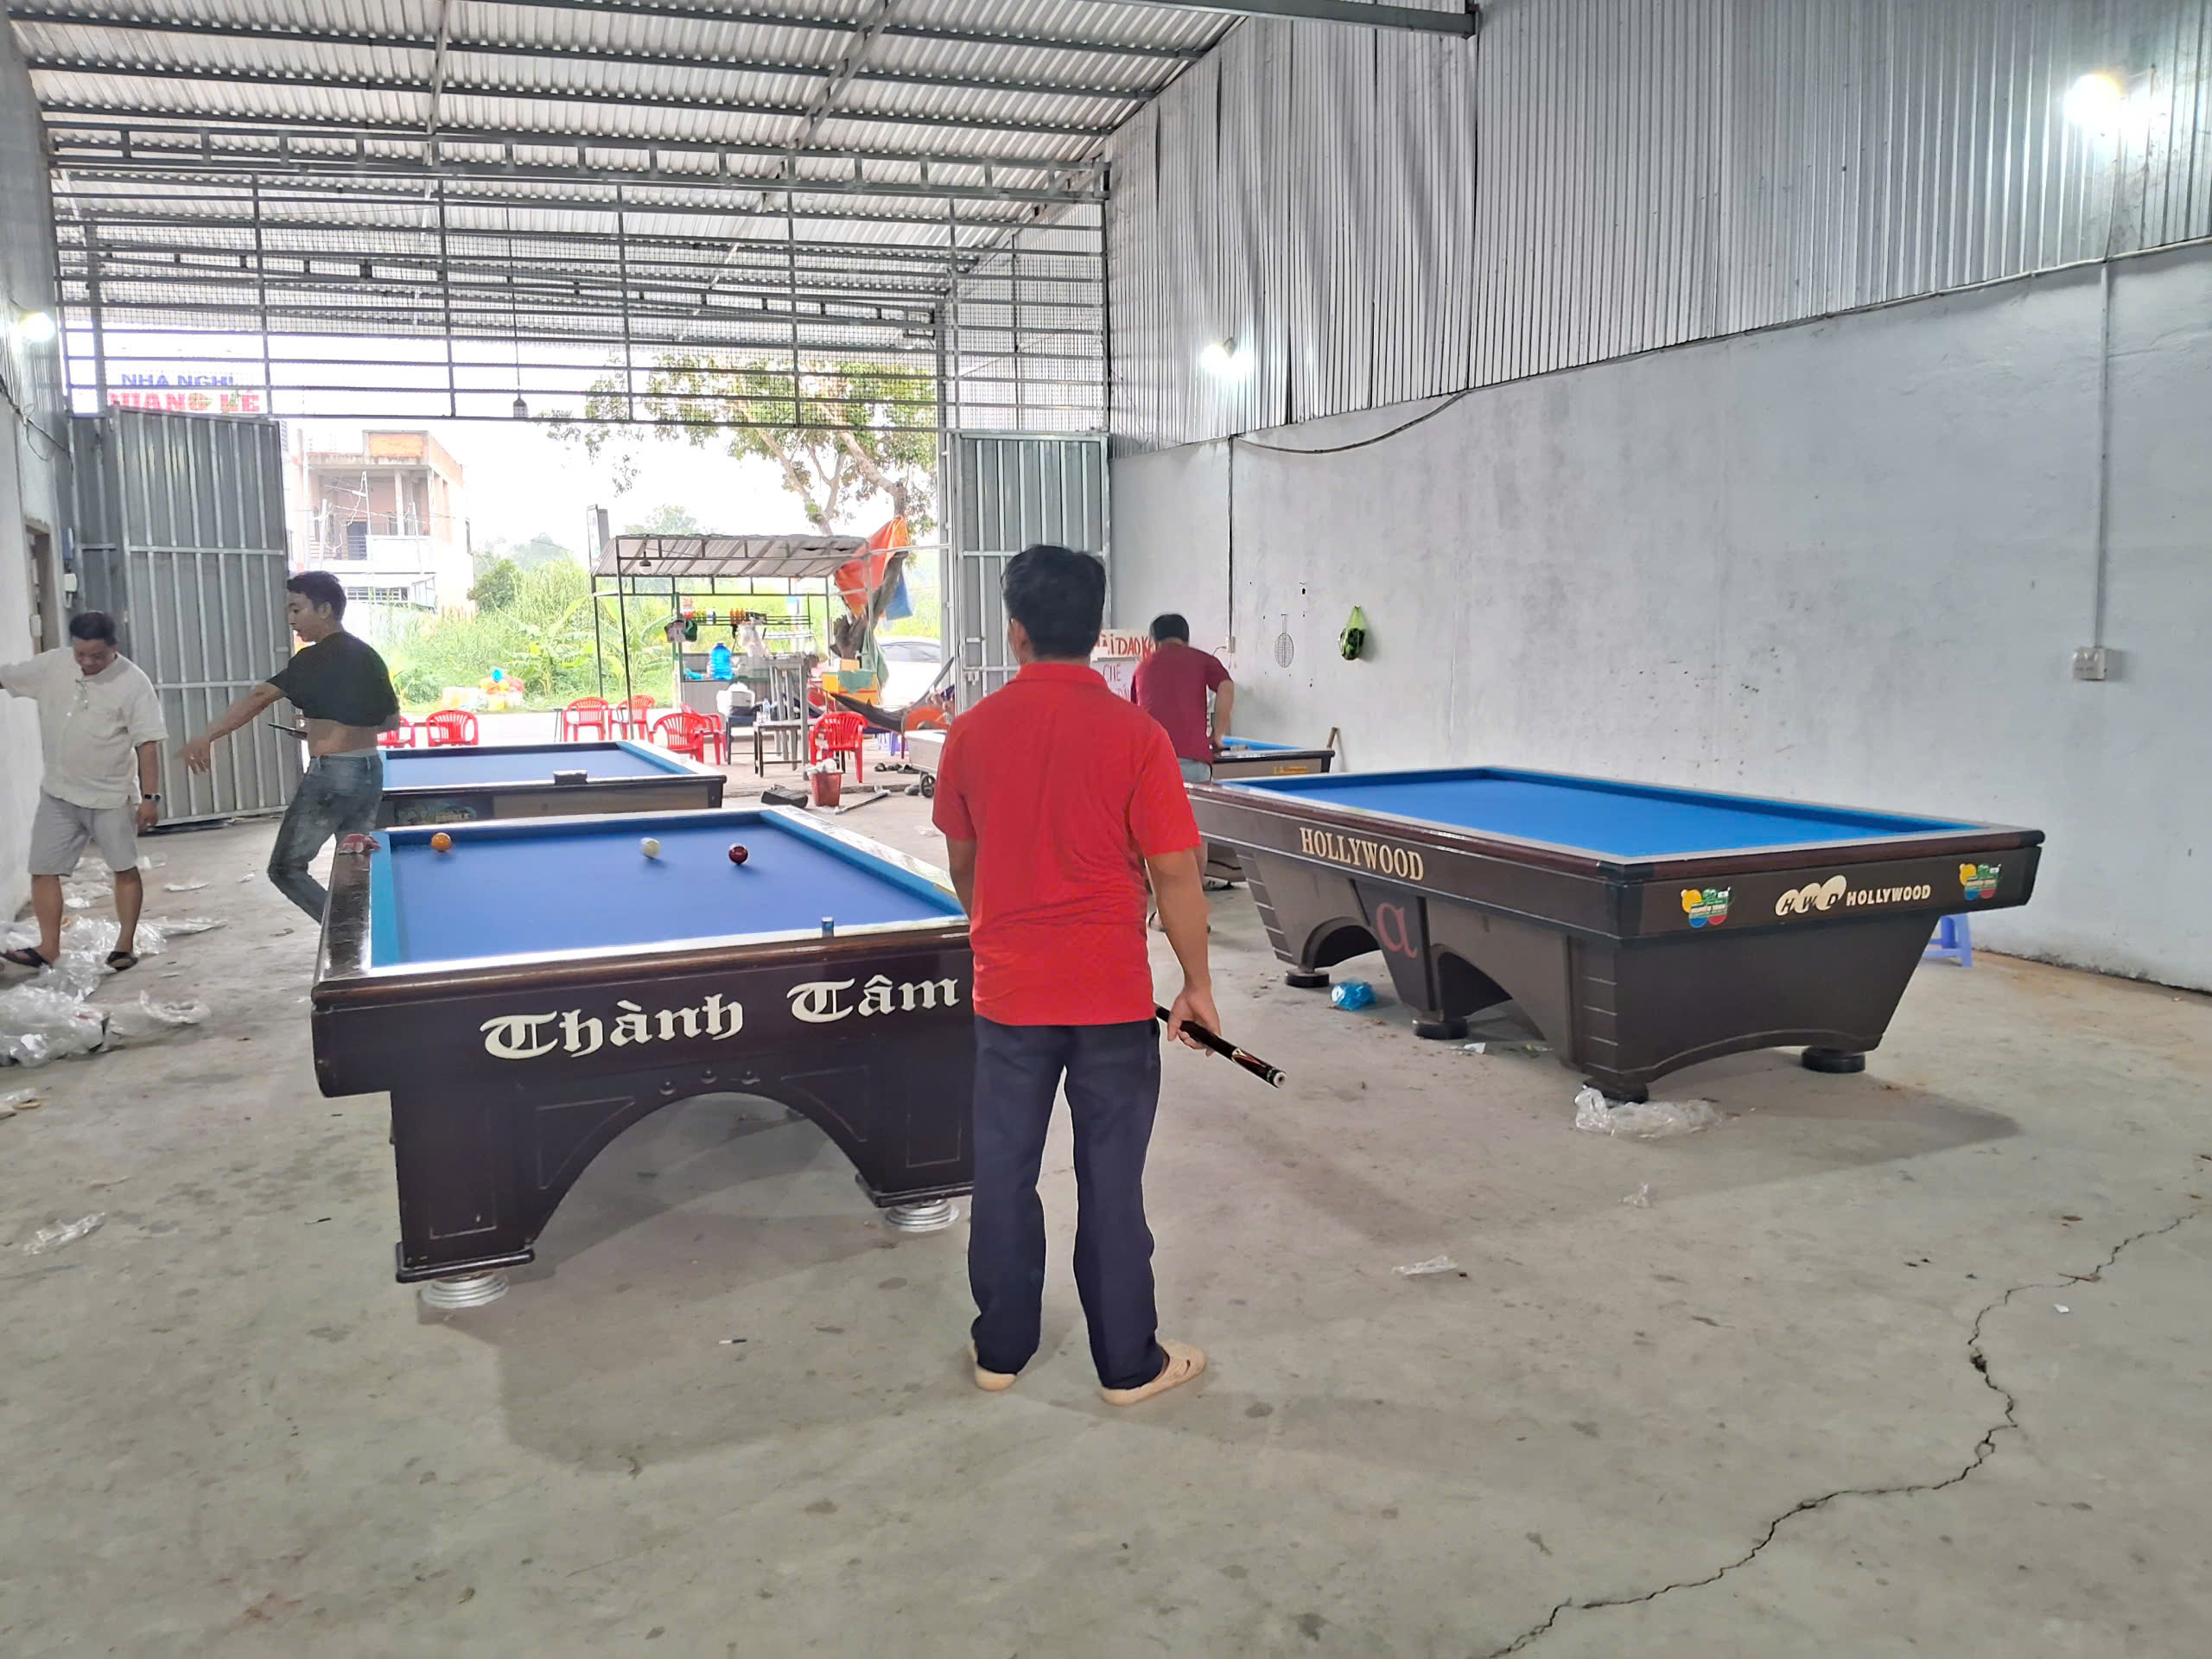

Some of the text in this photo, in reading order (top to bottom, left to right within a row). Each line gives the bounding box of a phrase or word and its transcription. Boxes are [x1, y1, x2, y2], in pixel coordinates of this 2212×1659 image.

[1299, 826, 1425, 881] HOLLYWOOD
[1846, 884, 1932, 907] HOLLYWOOD
[480, 974, 961, 1060] Thành Tâm
